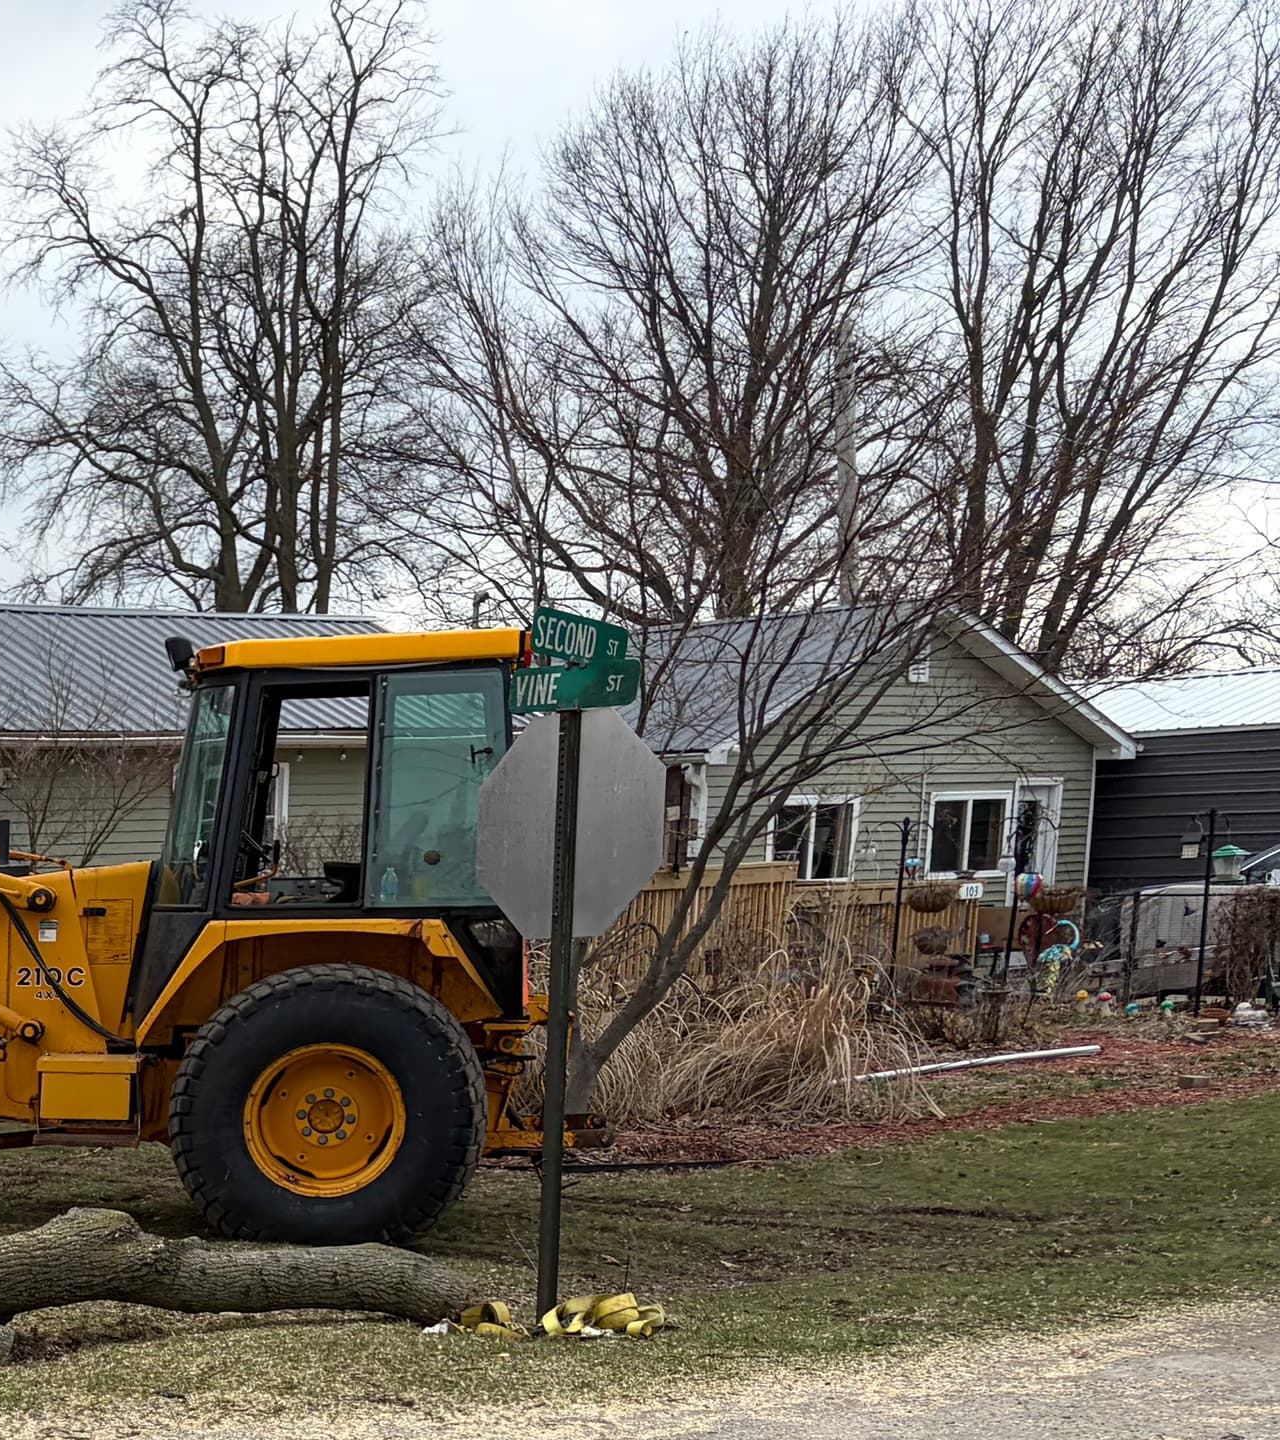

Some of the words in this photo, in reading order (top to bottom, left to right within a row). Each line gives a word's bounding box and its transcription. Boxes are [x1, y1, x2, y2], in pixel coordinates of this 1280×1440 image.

[534, 615, 598, 659] SECOND
[606, 639, 619, 657] ST
[516, 672, 561, 707] VINE
[606, 674, 624, 692] ST
[16, 967, 85, 987] 210C
